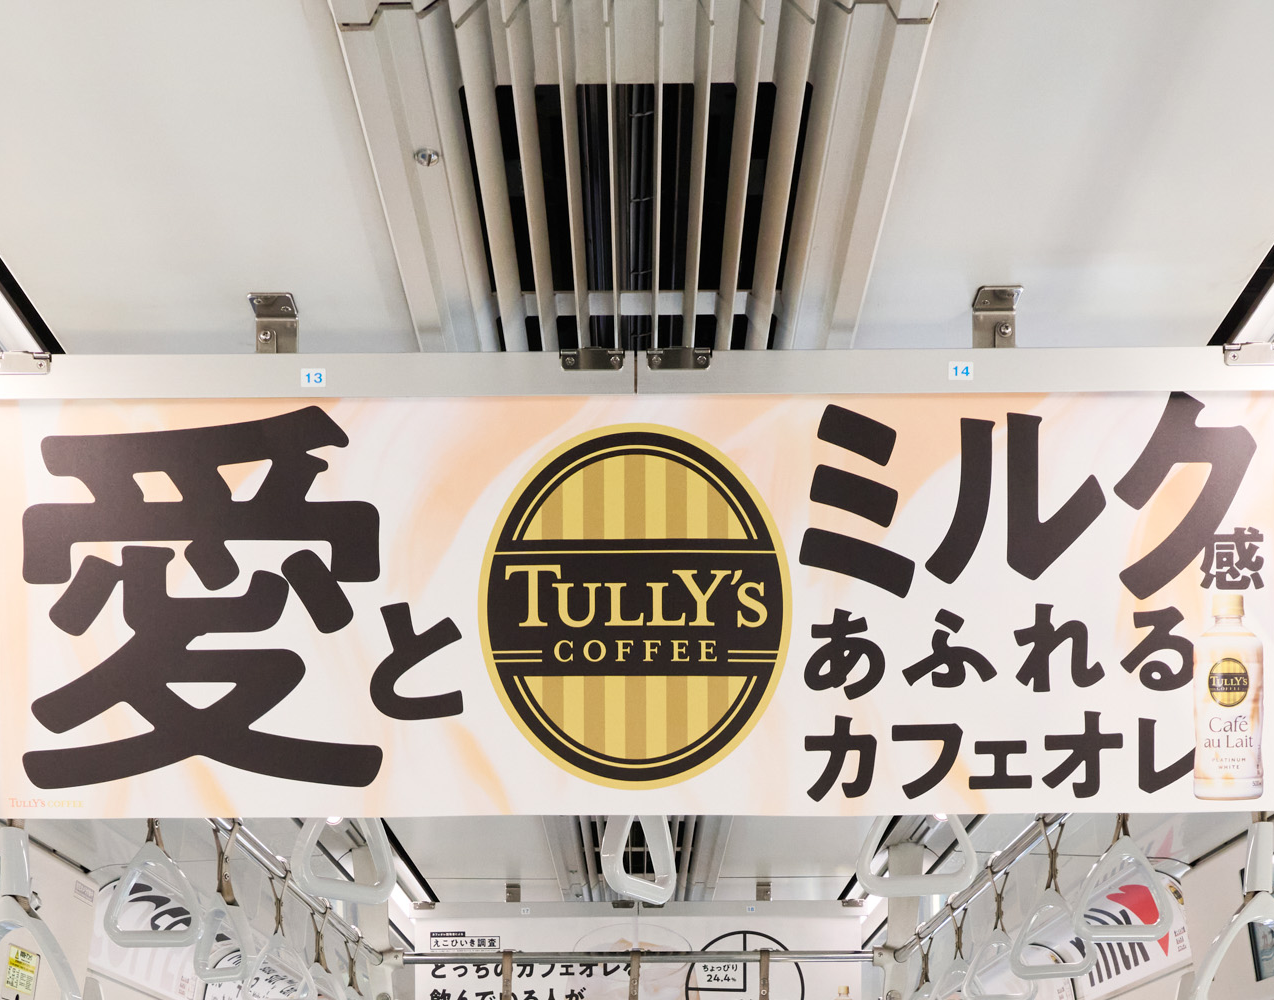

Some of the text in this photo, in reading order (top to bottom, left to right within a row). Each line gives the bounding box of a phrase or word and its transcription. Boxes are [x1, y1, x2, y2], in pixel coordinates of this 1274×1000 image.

[952, 364, 971, 377] 14
[304, 371, 323, 384] 13
[505, 564, 768, 629] TULLY'S
[554, 640, 718, 663] COFFEE
[803, 603, 1194, 700] あふれる
[1210, 675, 1248, 686] TULLY'S
[1209, 715, 1248, 732] Café
[1204, 735, 1253, 748] au Lait
[805, 711, 1196, 802] カフェオレ
[8, 798, 46, 808] TULLY'S
[433, 938, 497, 948] えこひいき調査
